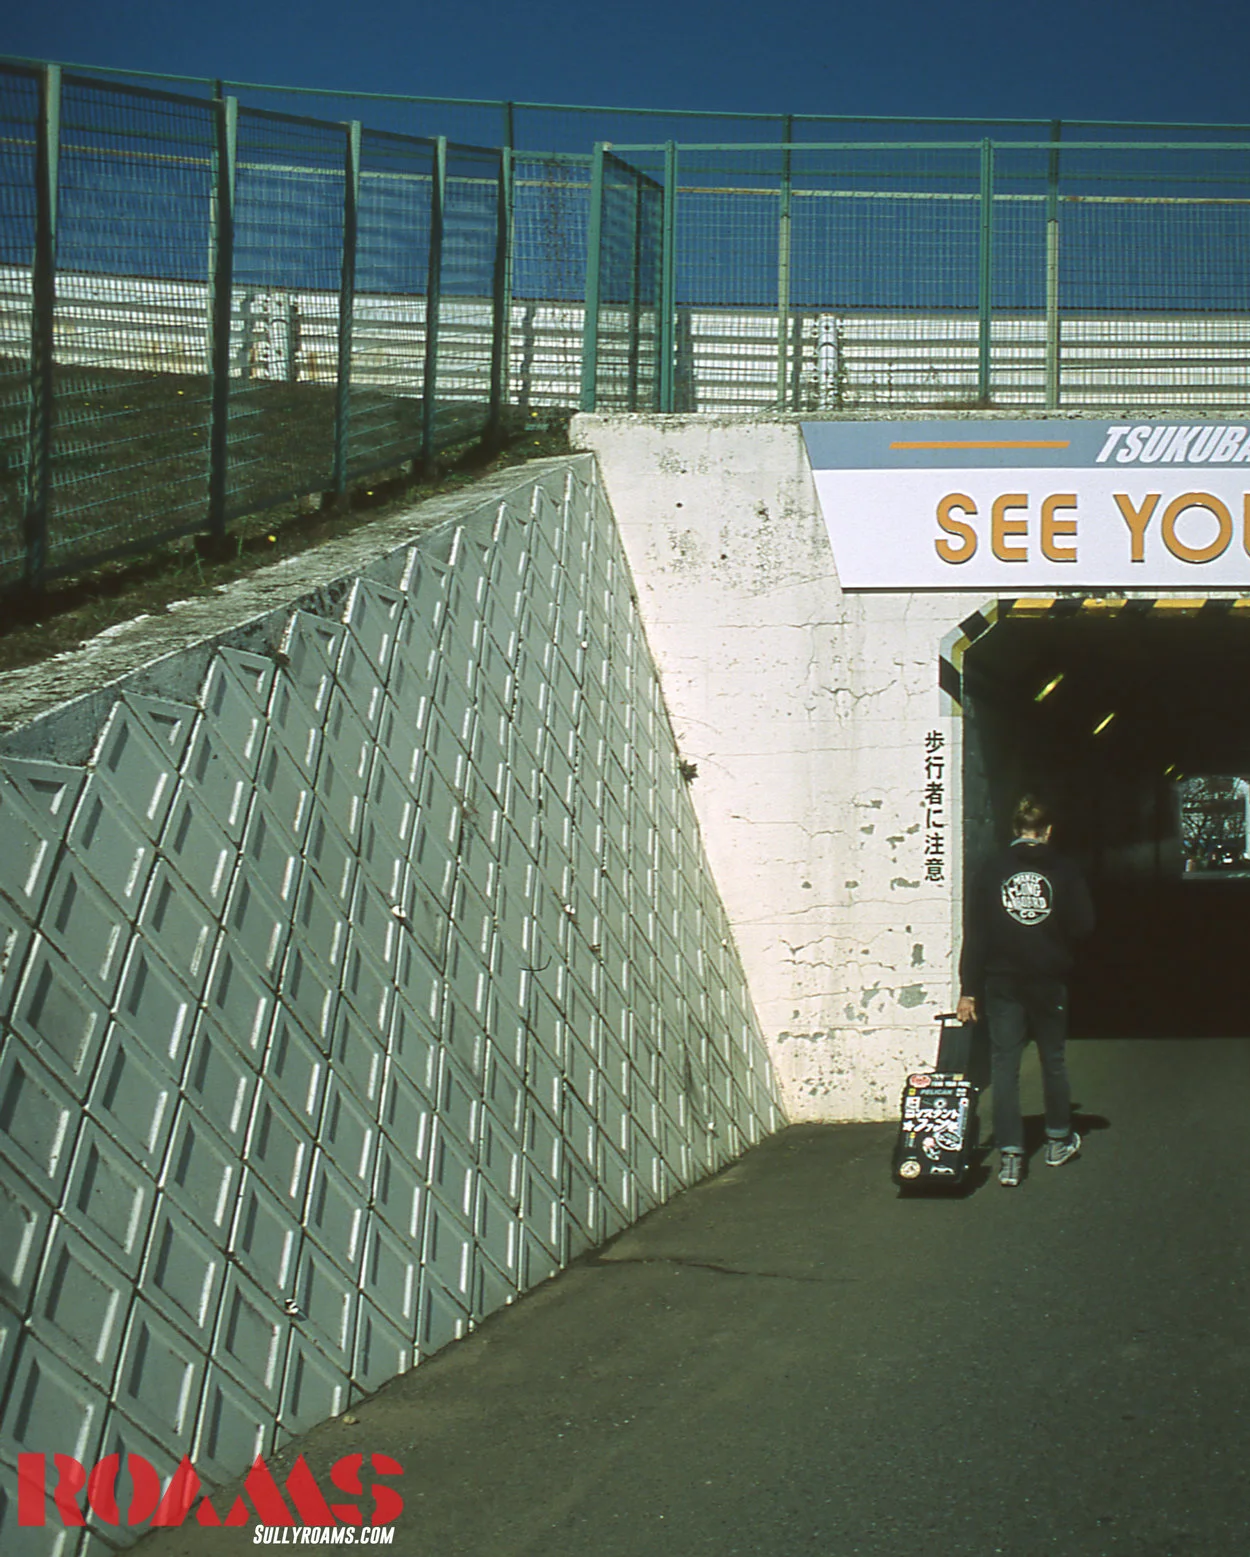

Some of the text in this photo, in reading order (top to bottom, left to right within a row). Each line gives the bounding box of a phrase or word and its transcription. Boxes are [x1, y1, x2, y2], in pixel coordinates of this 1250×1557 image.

[933, 492, 1079, 564] SEE
[925, 730, 945, 881] 歩行者に注意
[919, 1088, 953, 1096] PELICAN
